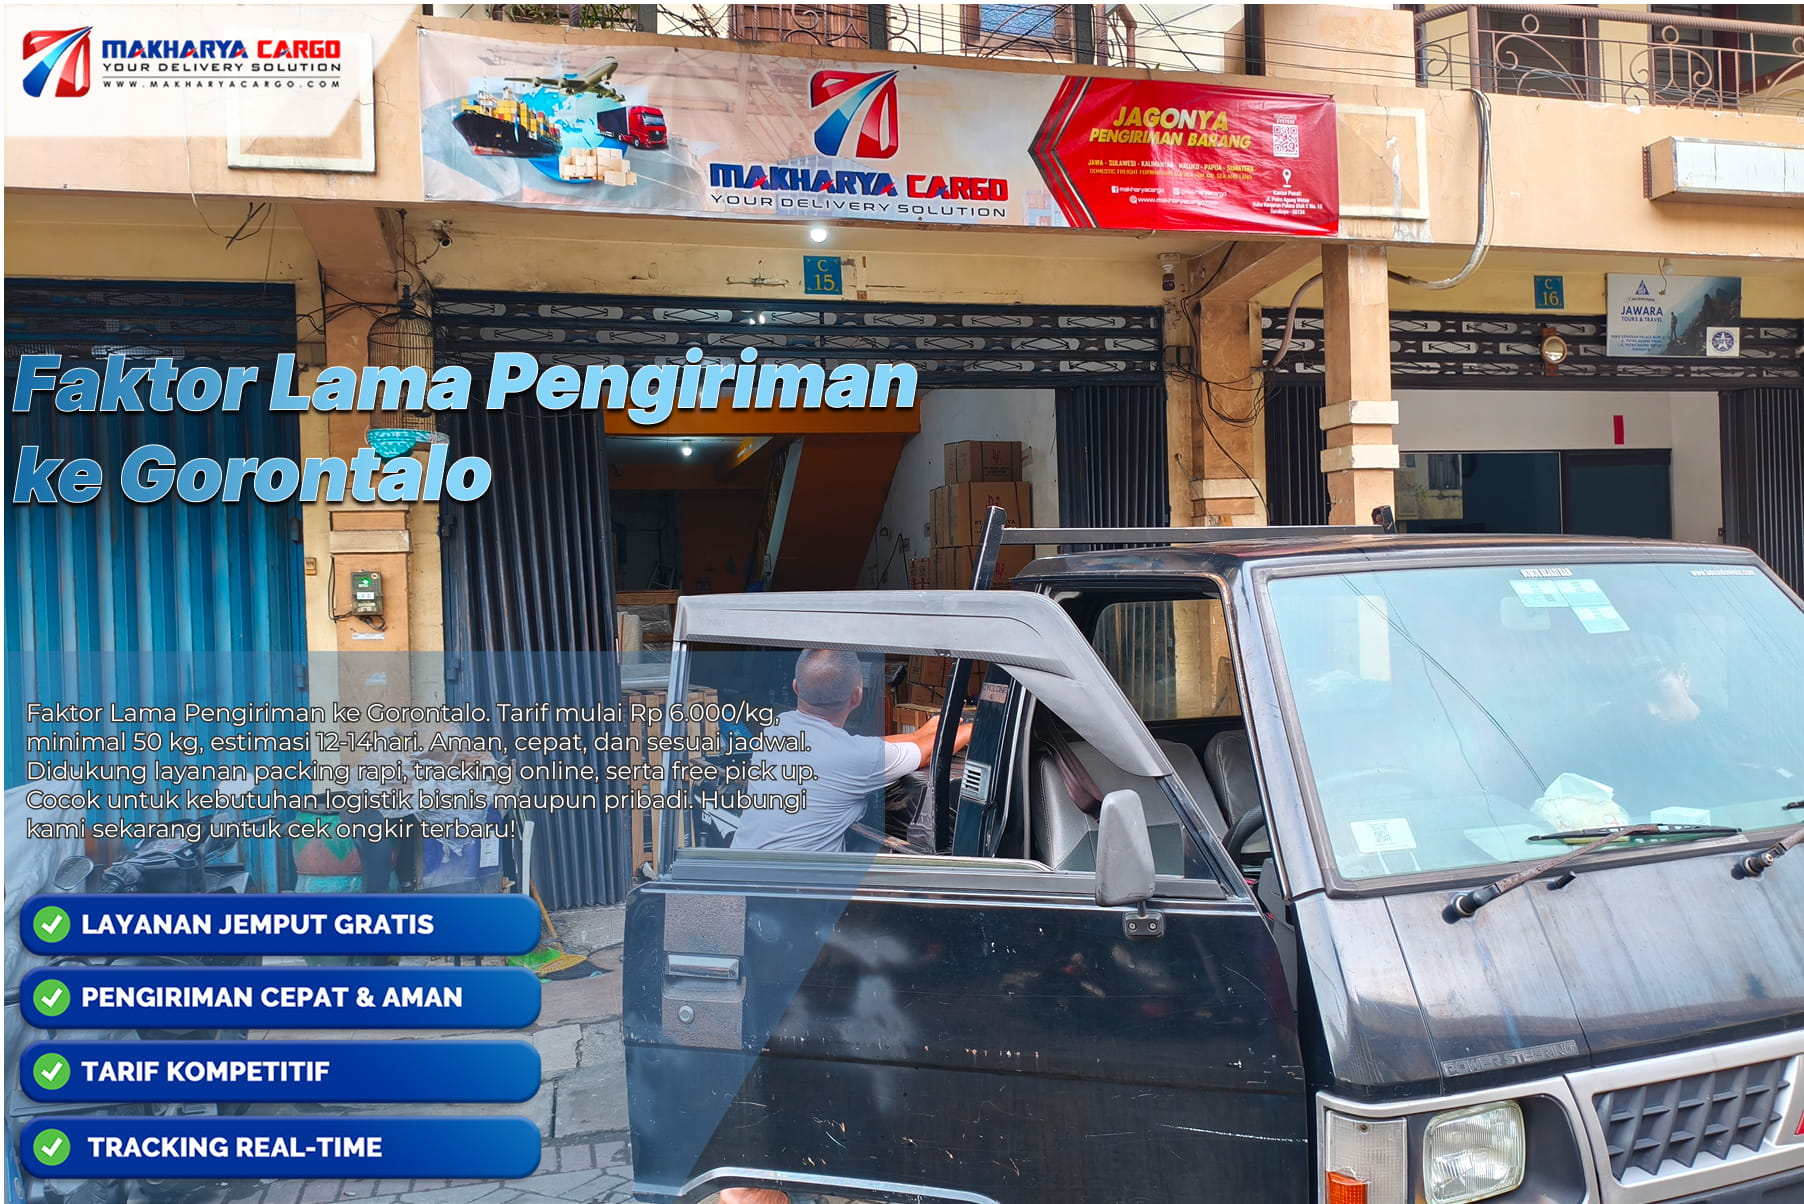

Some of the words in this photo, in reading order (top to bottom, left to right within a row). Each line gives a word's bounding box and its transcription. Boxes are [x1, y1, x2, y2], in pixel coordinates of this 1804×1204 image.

[1112, 106, 1229, 131] JAGONYA
[1089, 128, 1184, 146] PENGIRIMAN
[1187, 132, 1252, 149] BARANG
[1204, 163, 1222, 171] PAPUA
[709, 163, 899, 197] MAKHARYA
[906, 174, 1009, 201] CARGO
[710, 194, 773, 207] YOUR
[781, 198, 891, 212] DELIVERY
[897, 204, 1006, 217] SOLUTION
[817, 259, 829, 272] C
[814, 274, 835, 291] 15
[1544, 278, 1553, 290] C
[1543, 291, 1559, 306] 16
[1621, 306, 1663, 316] JAWARA
[1444, 1055, 1502, 1076] POWER
[1503, 1041, 1577, 1065] STEERING
